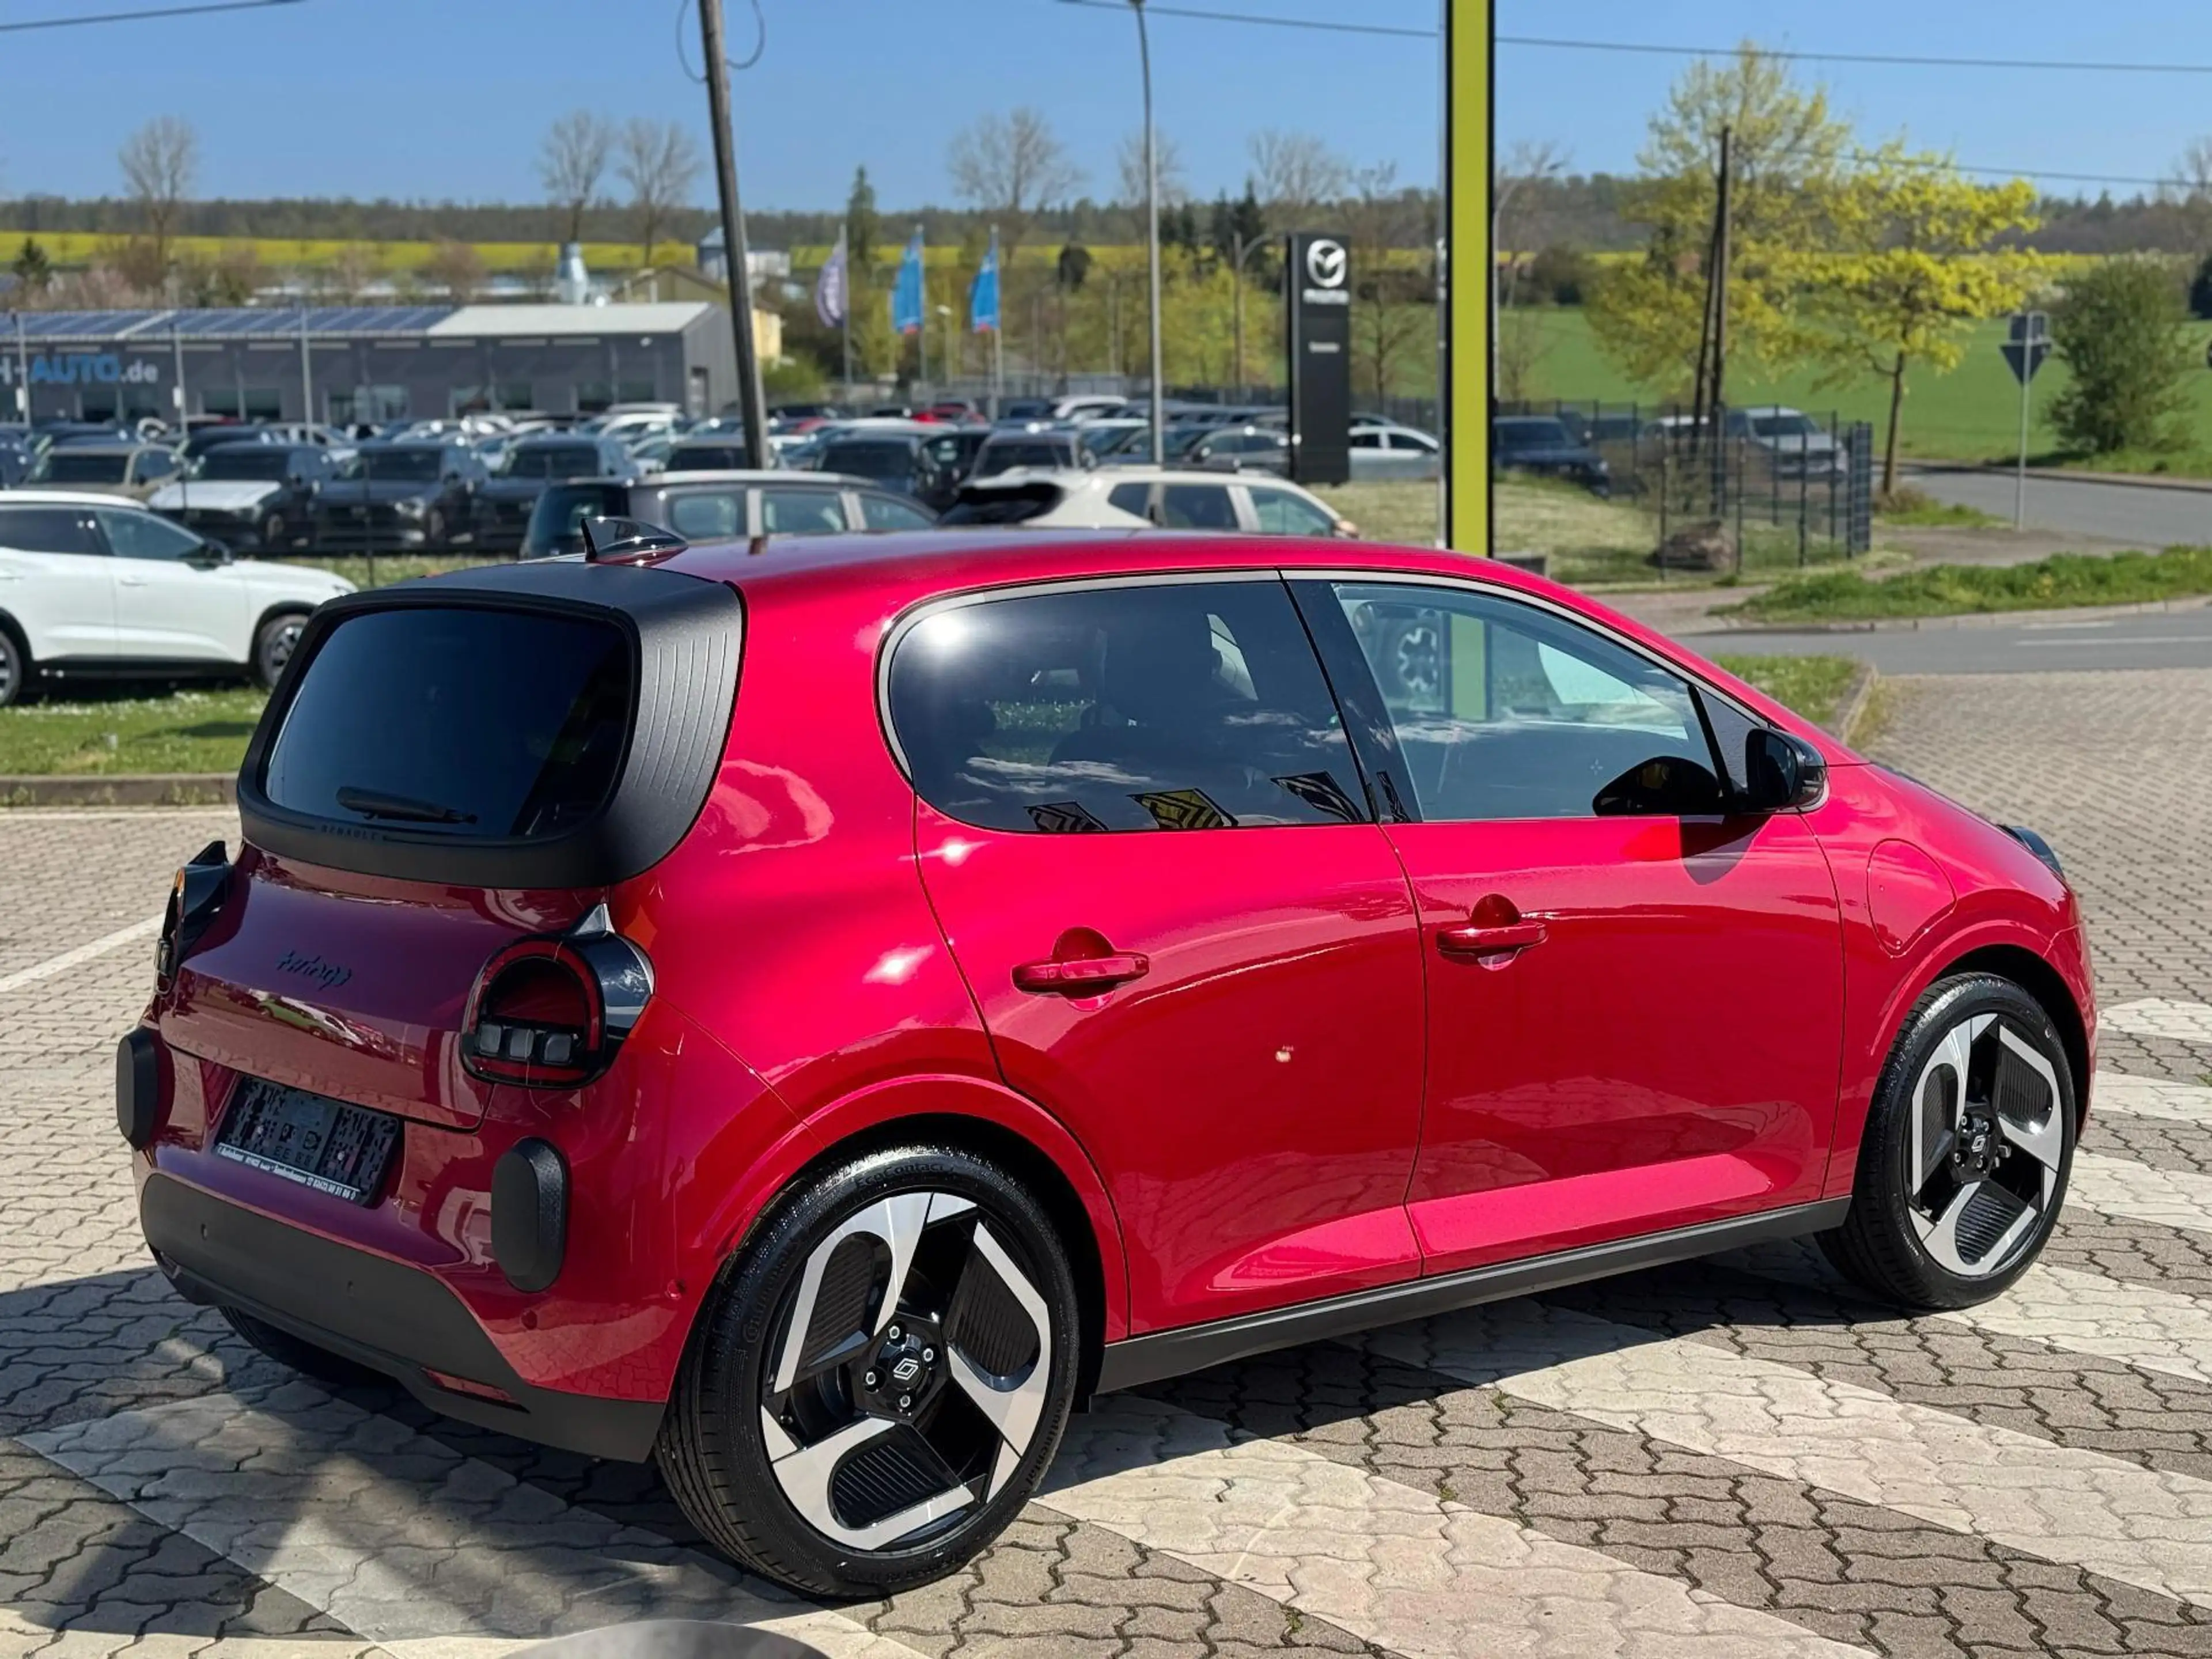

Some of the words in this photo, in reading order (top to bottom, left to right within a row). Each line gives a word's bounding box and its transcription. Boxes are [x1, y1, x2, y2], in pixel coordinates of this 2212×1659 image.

[322, 825, 380, 841] RENAULT
[855, 1162, 944, 1188] EcoContact
[1025, 1397, 1066, 1486] Continental
